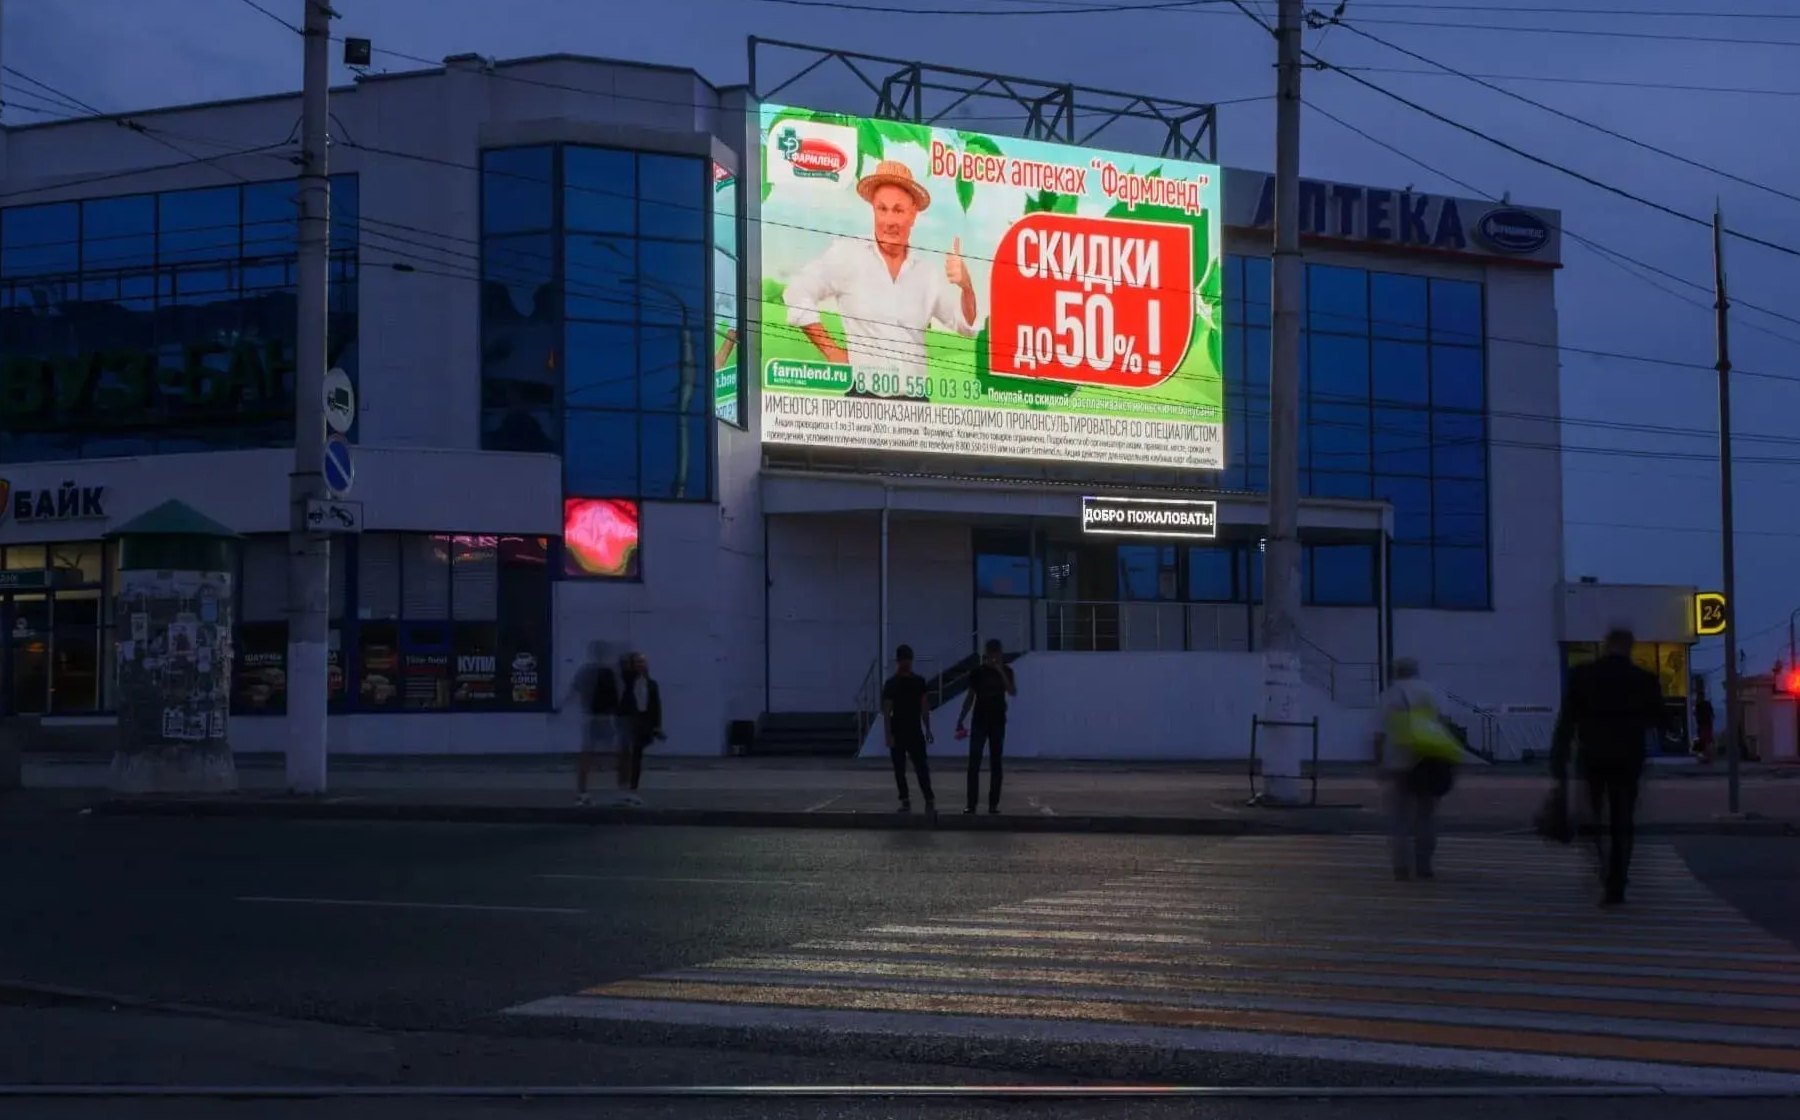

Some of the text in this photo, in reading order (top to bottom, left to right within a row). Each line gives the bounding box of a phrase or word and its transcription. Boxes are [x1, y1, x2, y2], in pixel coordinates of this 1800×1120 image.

[931, 141, 956, 177] Во
[963, 151, 1006, 183] всех
[1011, 161, 1086, 194] аптеках
[1017, 228, 1160, 293] СКИДКИ
[773, 363, 847, 383] farmlend.ru
[857, 372, 982, 400] 8 800 550 03 93
[988, 387, 1022, 406] Покупай
[1024, 394, 1034, 404] со
[765, 396, 819, 416] ИМЕЮТСЯ
[1006, 412, 1127, 438] ПРОКОНСУЛЬТИРОВАТЬСЯ
[1131, 420, 1142, 438] СО
[14, 481, 104, 519] БАЙК
[1086, 508, 1213, 527] ДОБРО ПОЖАЛОВАТЬ!
[1703, 605, 1721, 621] 24
[457, 655, 497, 673] КУПИ
